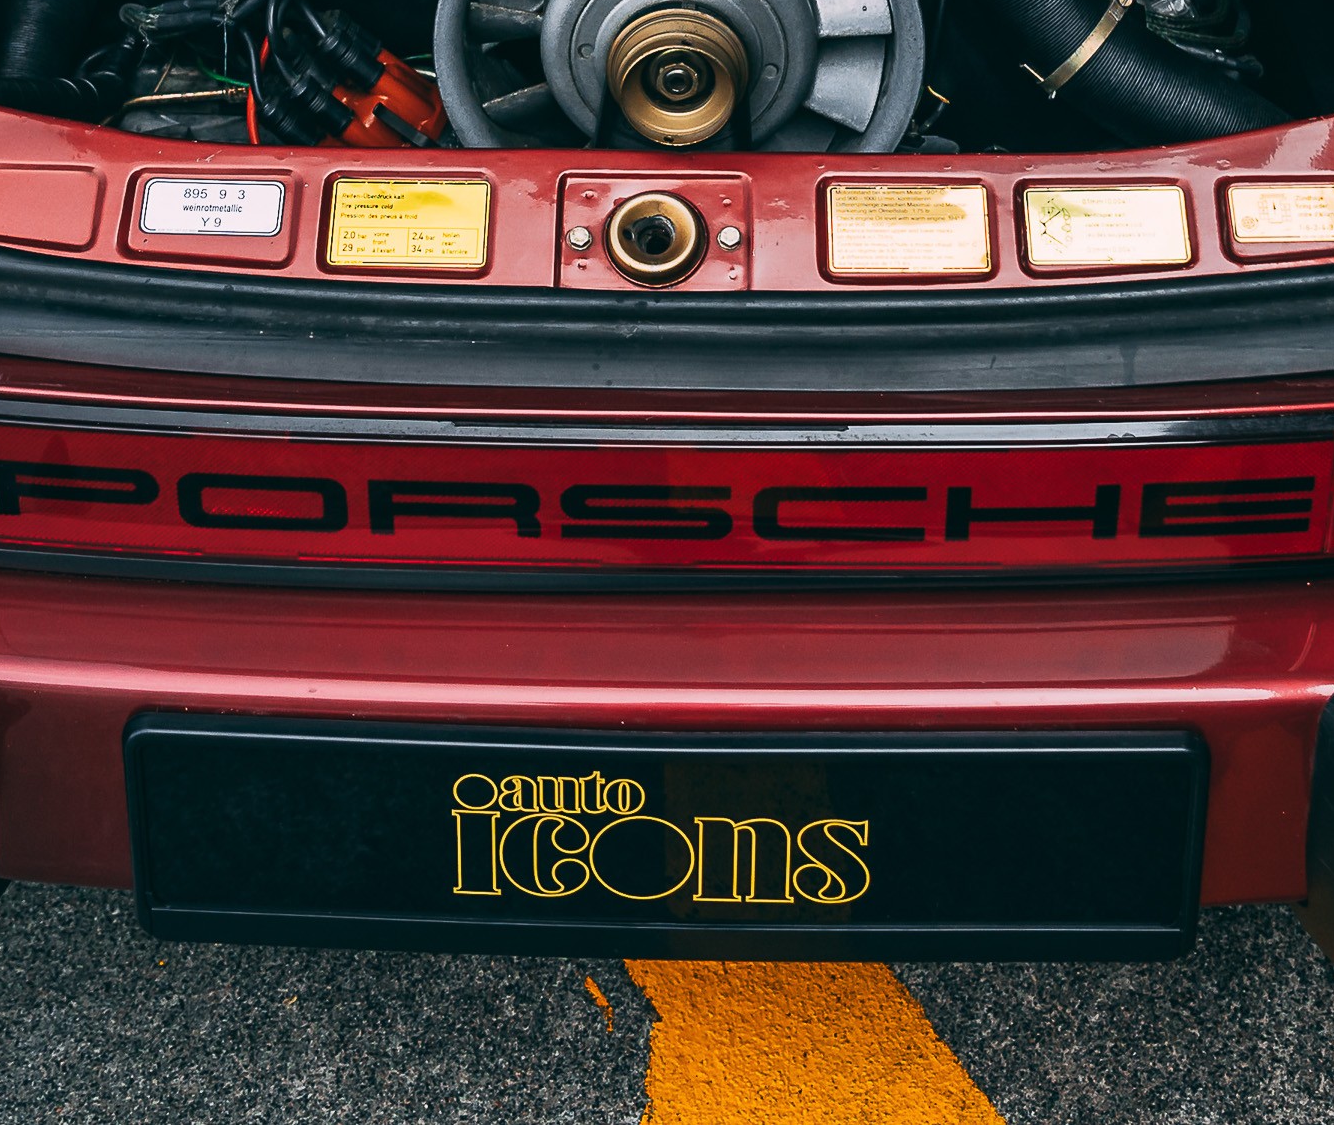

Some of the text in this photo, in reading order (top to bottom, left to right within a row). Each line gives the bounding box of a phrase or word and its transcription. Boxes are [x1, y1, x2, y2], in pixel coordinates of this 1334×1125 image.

[183, 188, 246, 200] 895 9 3
[183, 203, 243, 213] weinrotmetallic
[201, 217, 222, 228] Y 9
[342, 243, 353, 252] 29
[411, 245, 422, 253] 34
[498, 771, 646, 815] auto
[452, 774, 871, 905] icons
